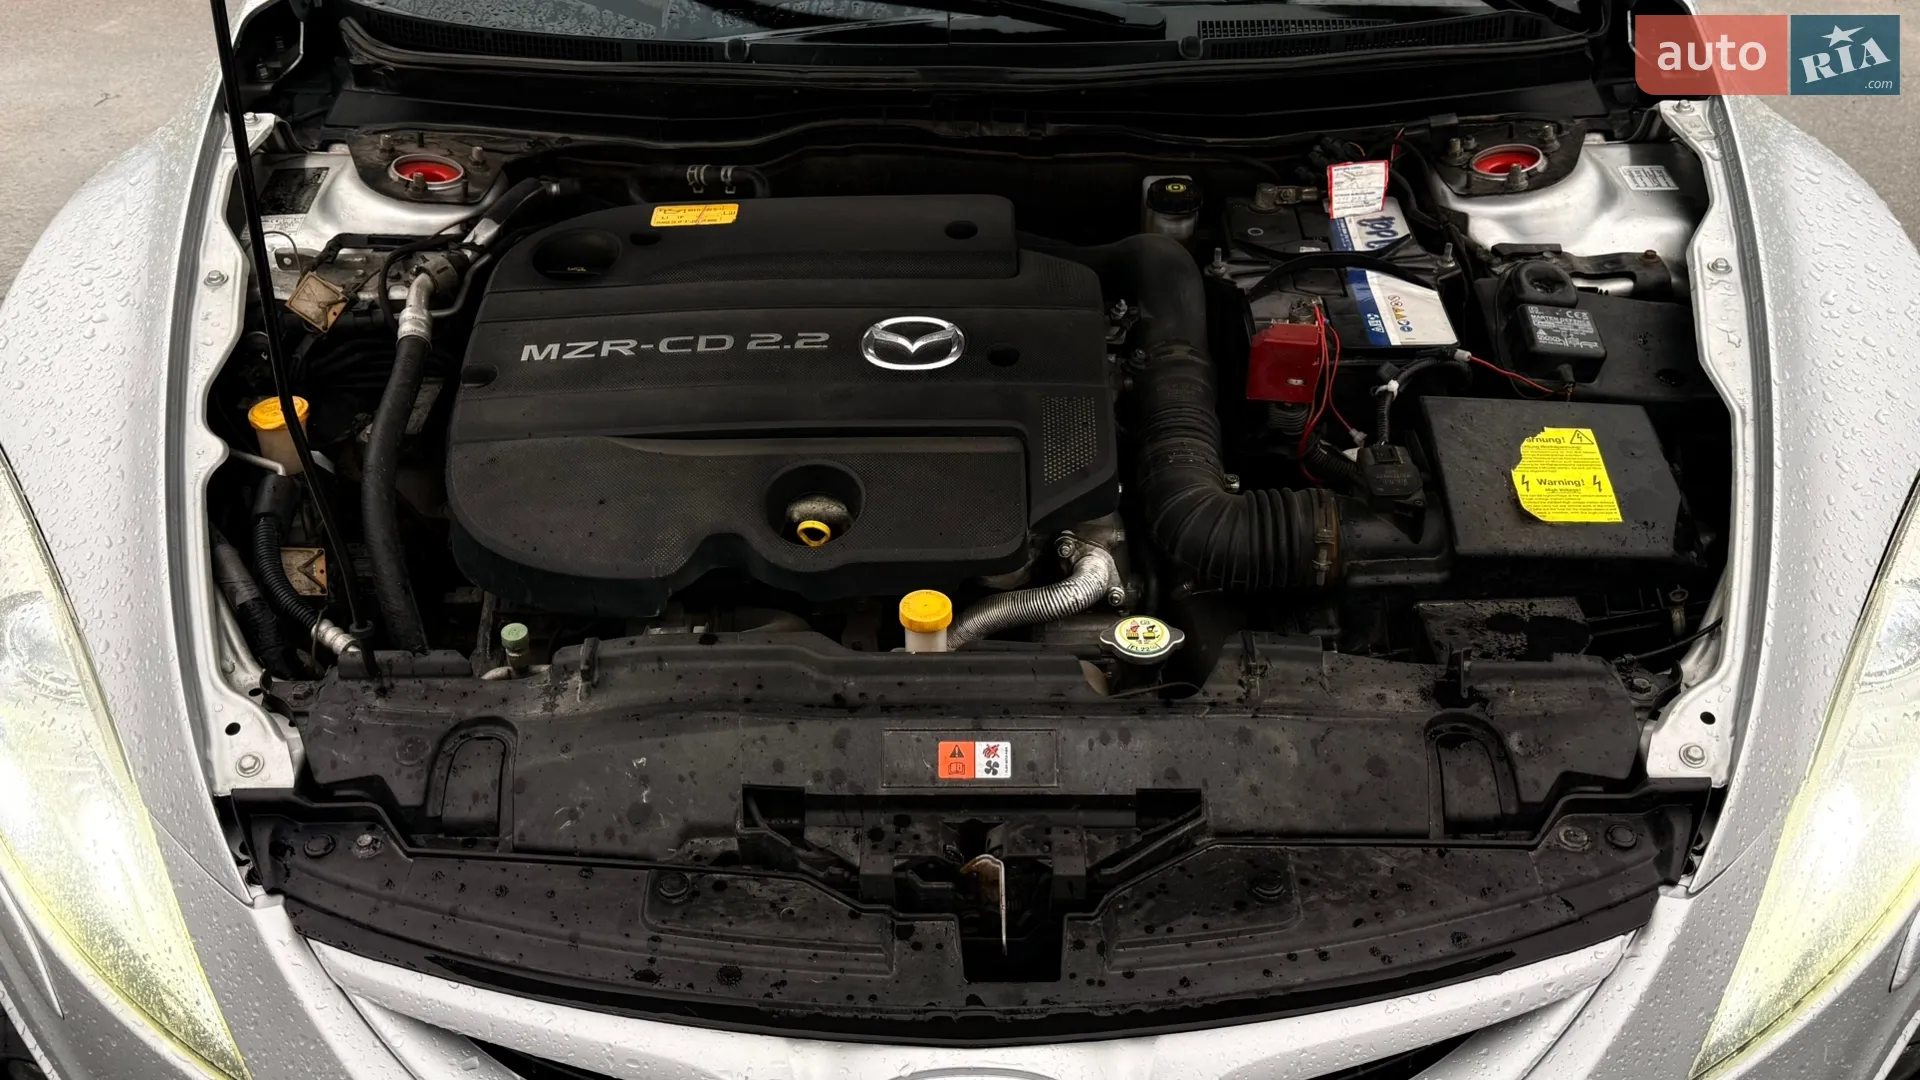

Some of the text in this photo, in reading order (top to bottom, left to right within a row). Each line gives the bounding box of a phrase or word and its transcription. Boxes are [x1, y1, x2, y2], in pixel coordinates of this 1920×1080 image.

[521, 332, 830, 361] MZR-CD 2.2
[1536, 478, 1585, 487] Warning!
